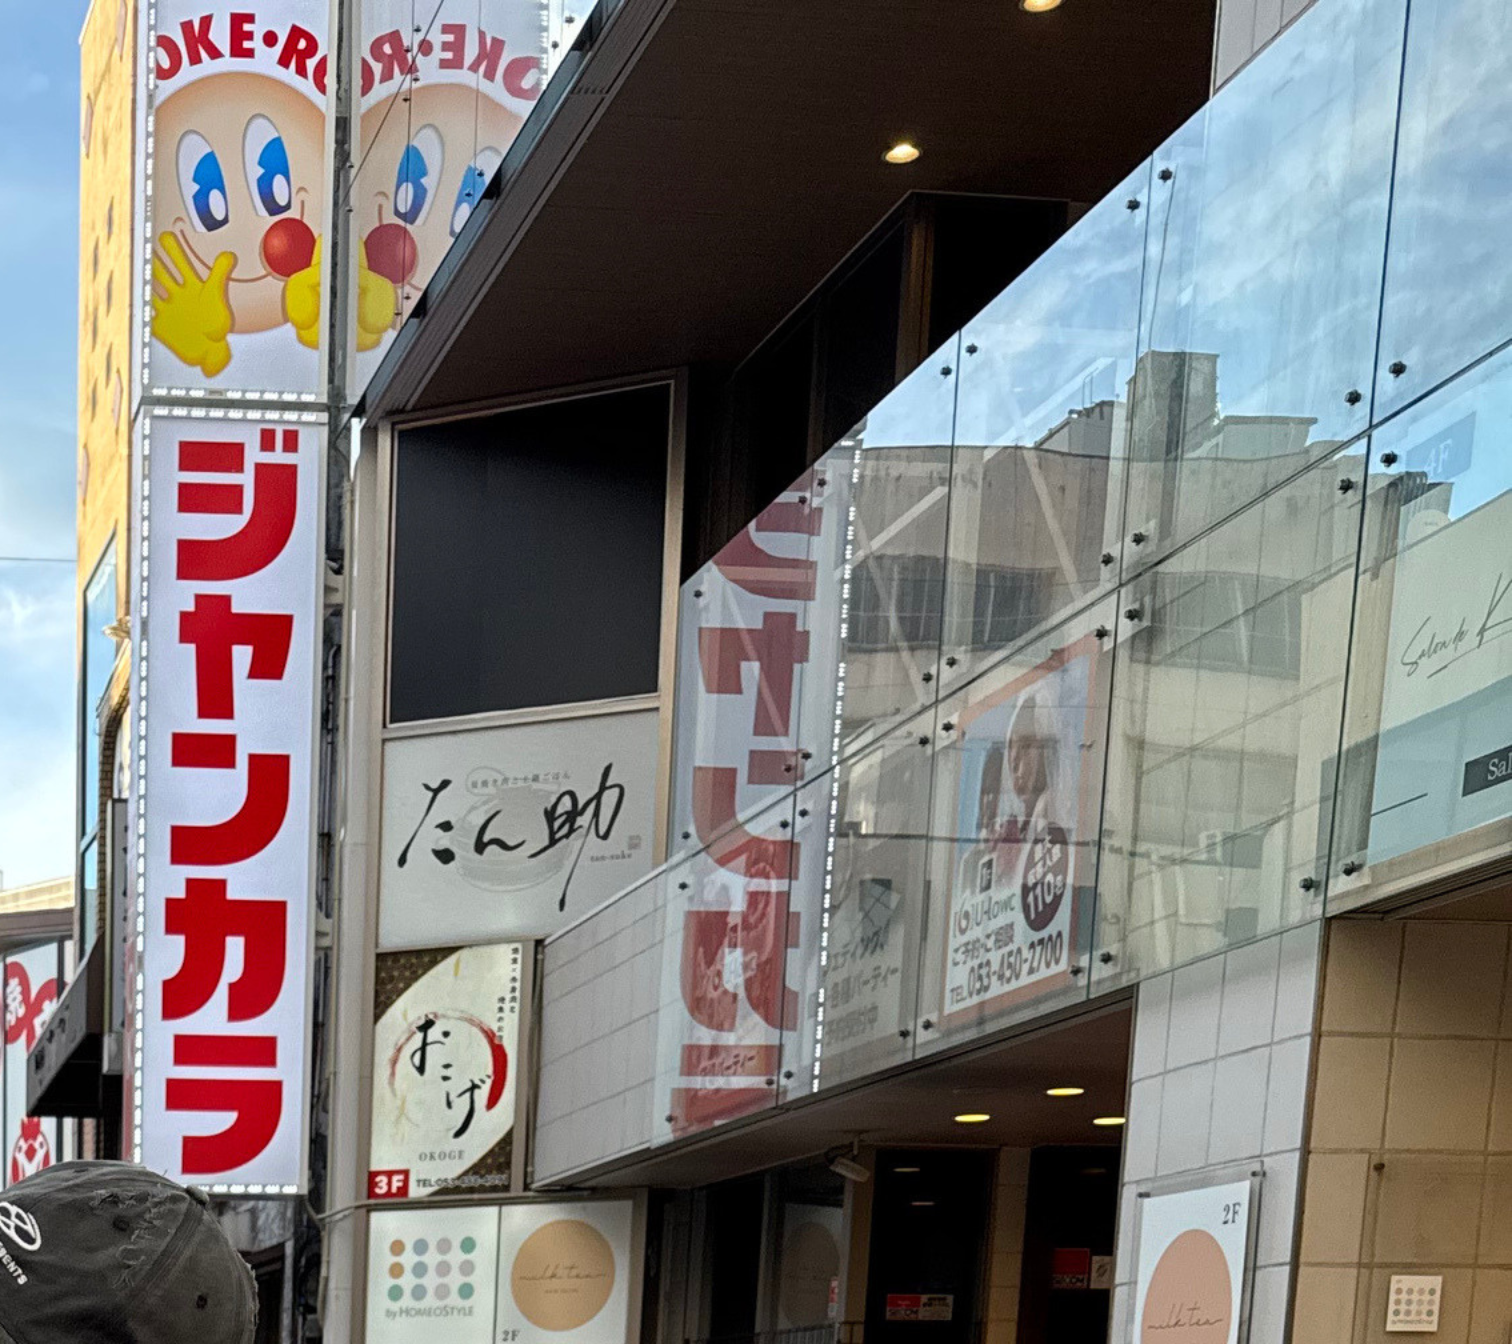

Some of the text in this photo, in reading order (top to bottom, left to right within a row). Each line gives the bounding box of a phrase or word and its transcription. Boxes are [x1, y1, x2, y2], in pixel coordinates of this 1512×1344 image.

[161, 428, 298, 1176] ジャンカラ
[967, 930, 1064, 999] 053-450-2700
[410, 1014, 491, 1139] おこげ
[418, 1150, 465, 1162] OKOGE
[374, 1174, 405, 1195] 3F
[1222, 1202, 1242, 1225] 2F
[385, 1306, 397, 1320] by
[502, 1330, 520, 1342] 2F
